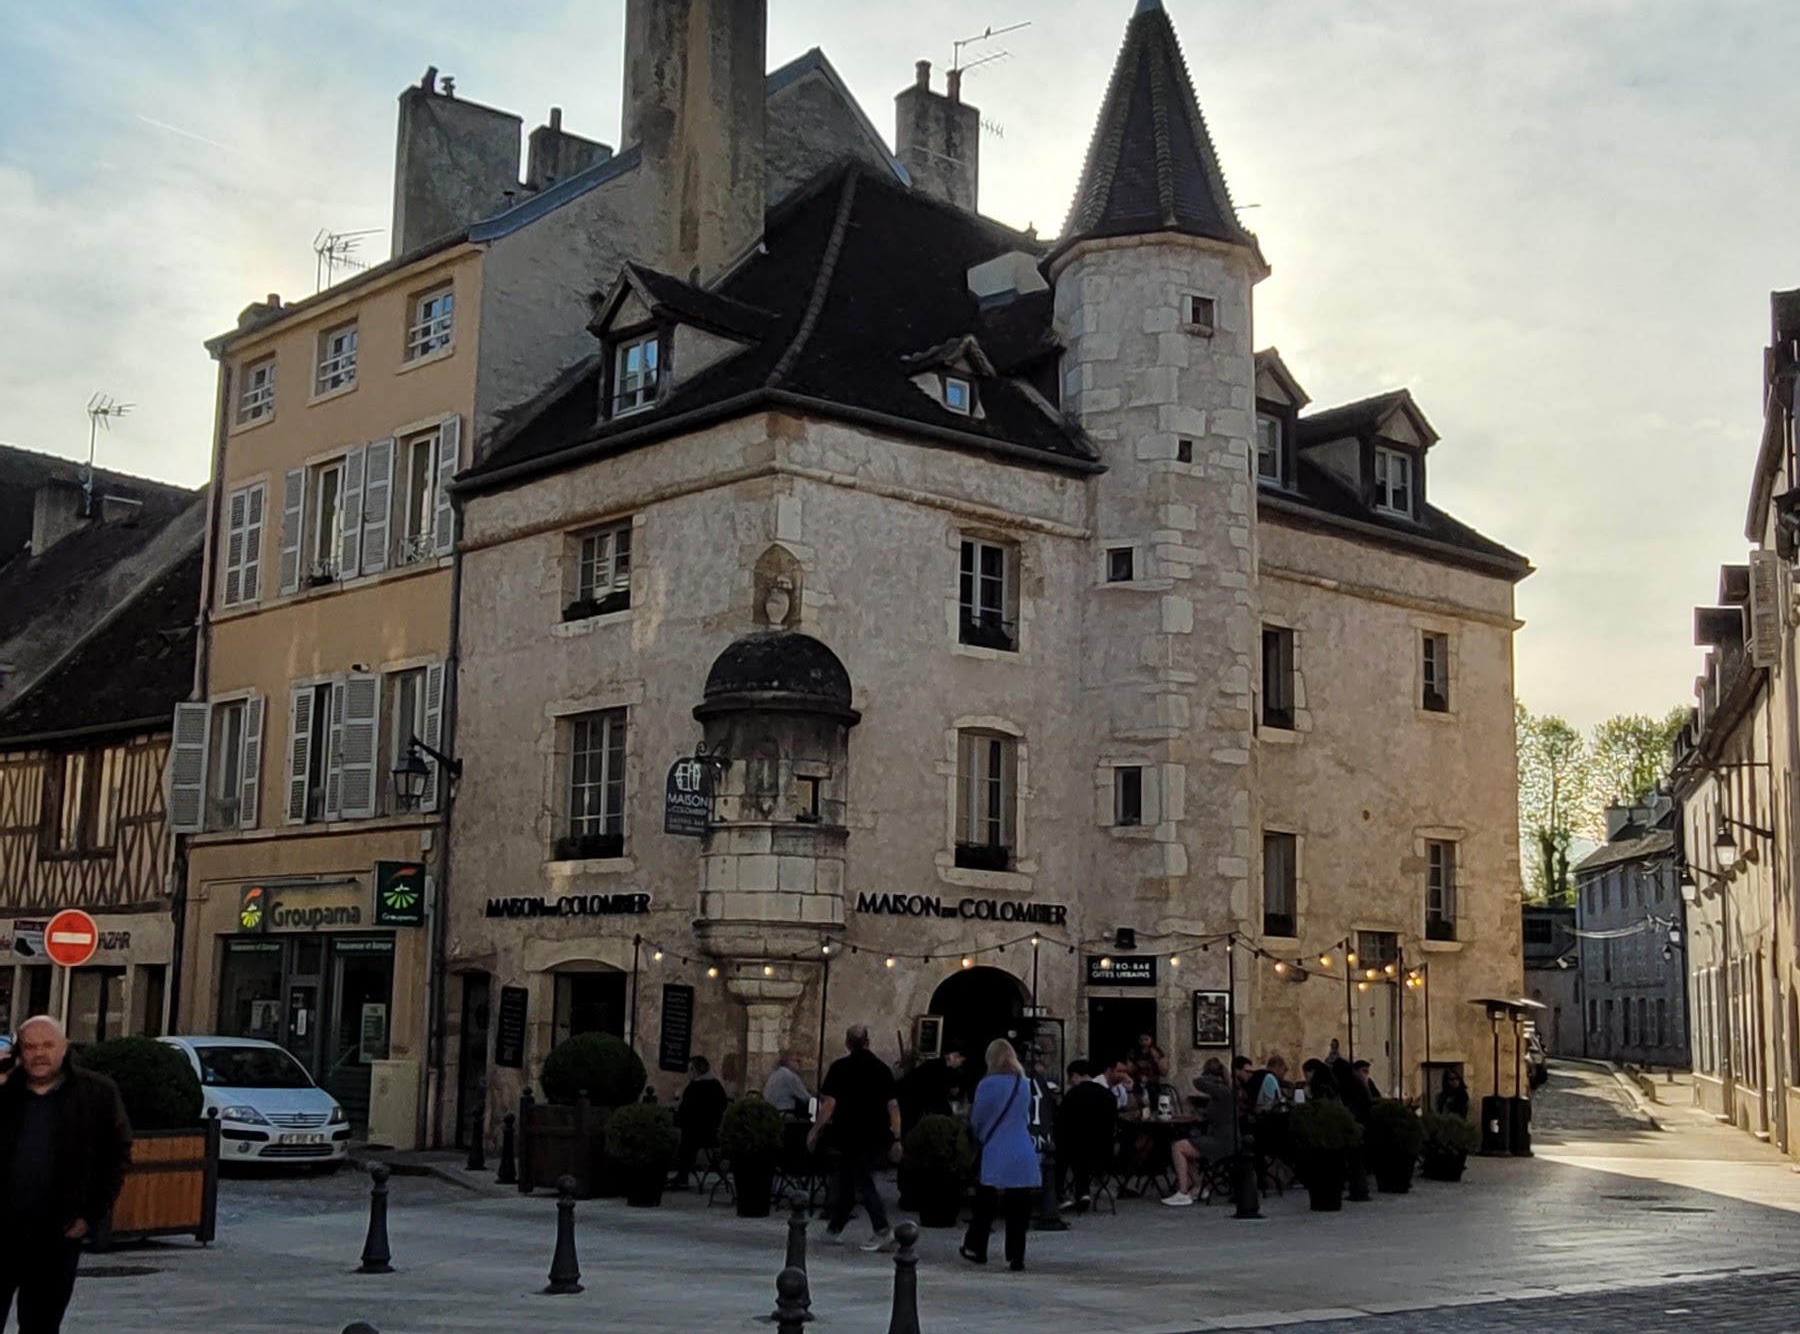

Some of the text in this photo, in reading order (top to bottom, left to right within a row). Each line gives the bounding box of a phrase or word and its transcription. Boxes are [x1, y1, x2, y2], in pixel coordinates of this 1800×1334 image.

[668, 793, 708, 807] MAISON
[271, 901, 360, 929] Groupama
[486, 897, 544, 917] MAISON
[557, 893, 649, 917] COLOMBIER
[857, 892, 940, 917] MAISON
[958, 898, 1067, 926] COLOMBIER
[98, 931, 131, 950] AZAR
